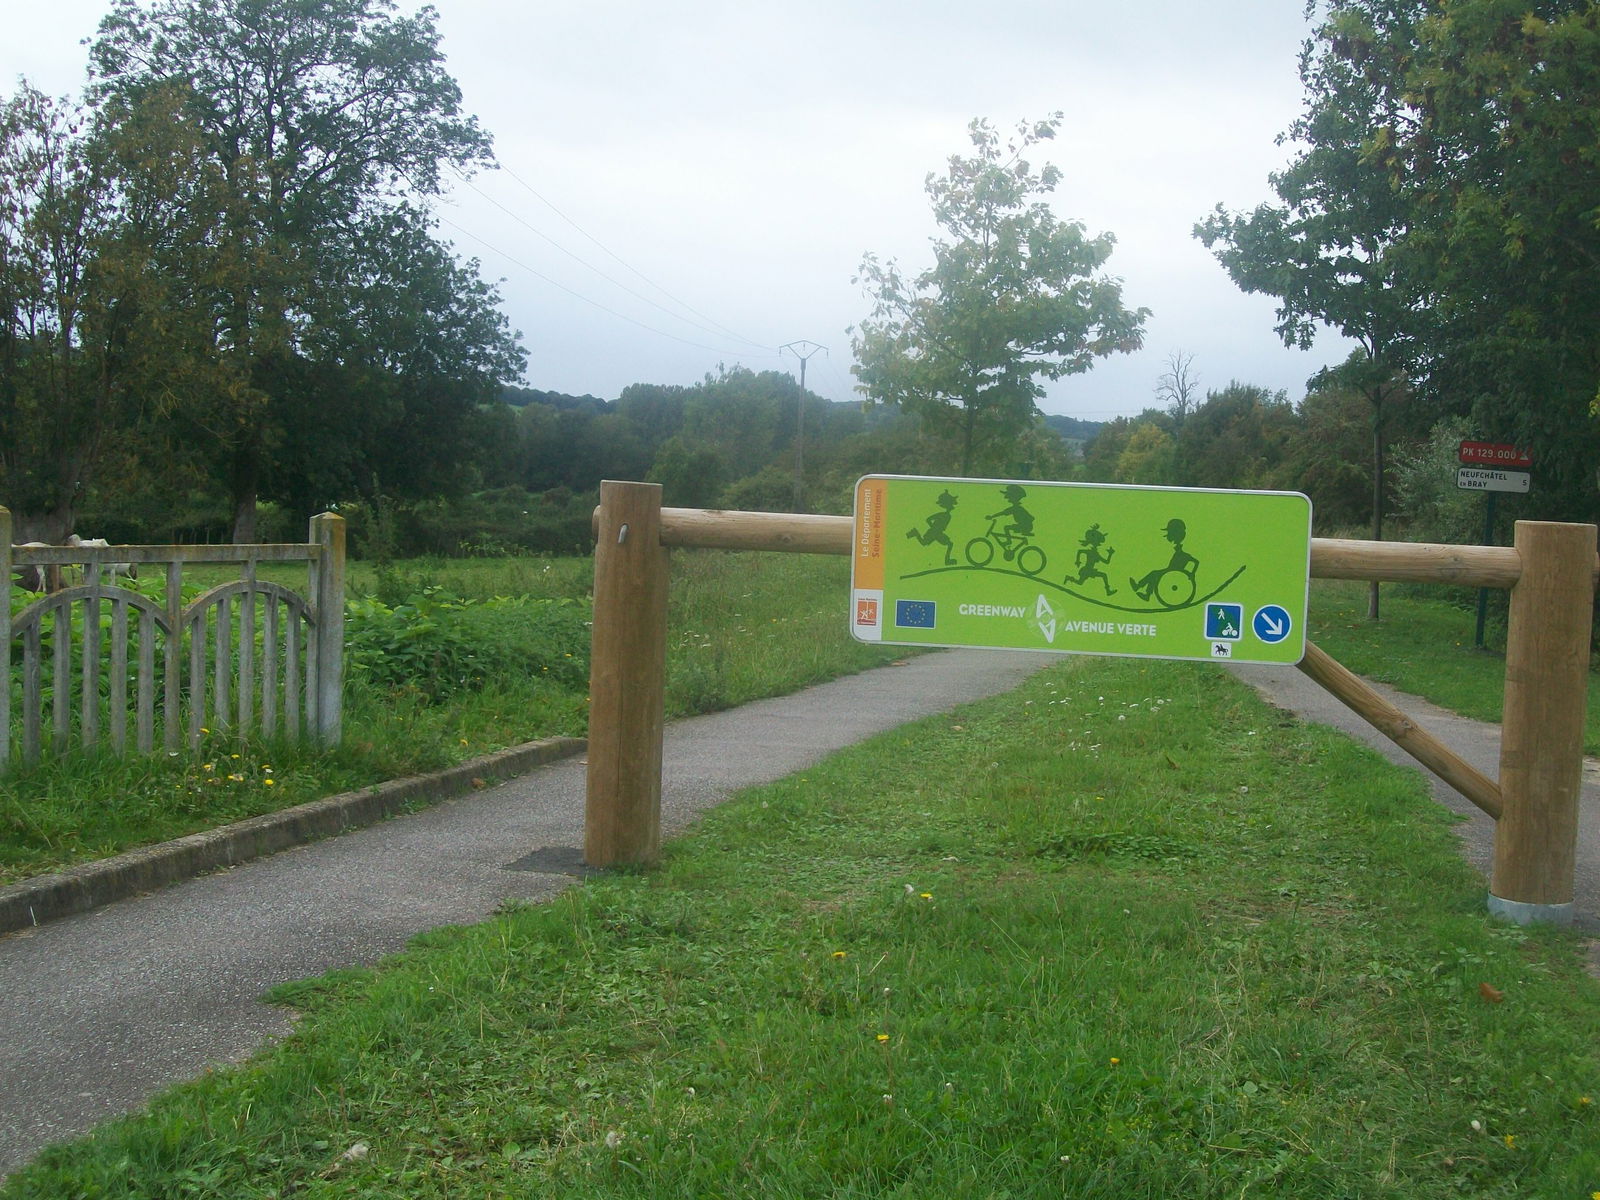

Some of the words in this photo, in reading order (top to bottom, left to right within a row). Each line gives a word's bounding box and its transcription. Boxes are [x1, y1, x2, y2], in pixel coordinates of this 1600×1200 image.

[1462, 447, 1474, 457] PK
[1467, 480, 1488, 488] BRAY
[871, 488, 882, 558] Seine-Maritime
[861, 547, 869, 557] Le
[959, 603, 1026, 618] GREENWAY
[1065, 620, 1114, 635] AVENUE
[1117, 622, 1157, 637] VERTE
